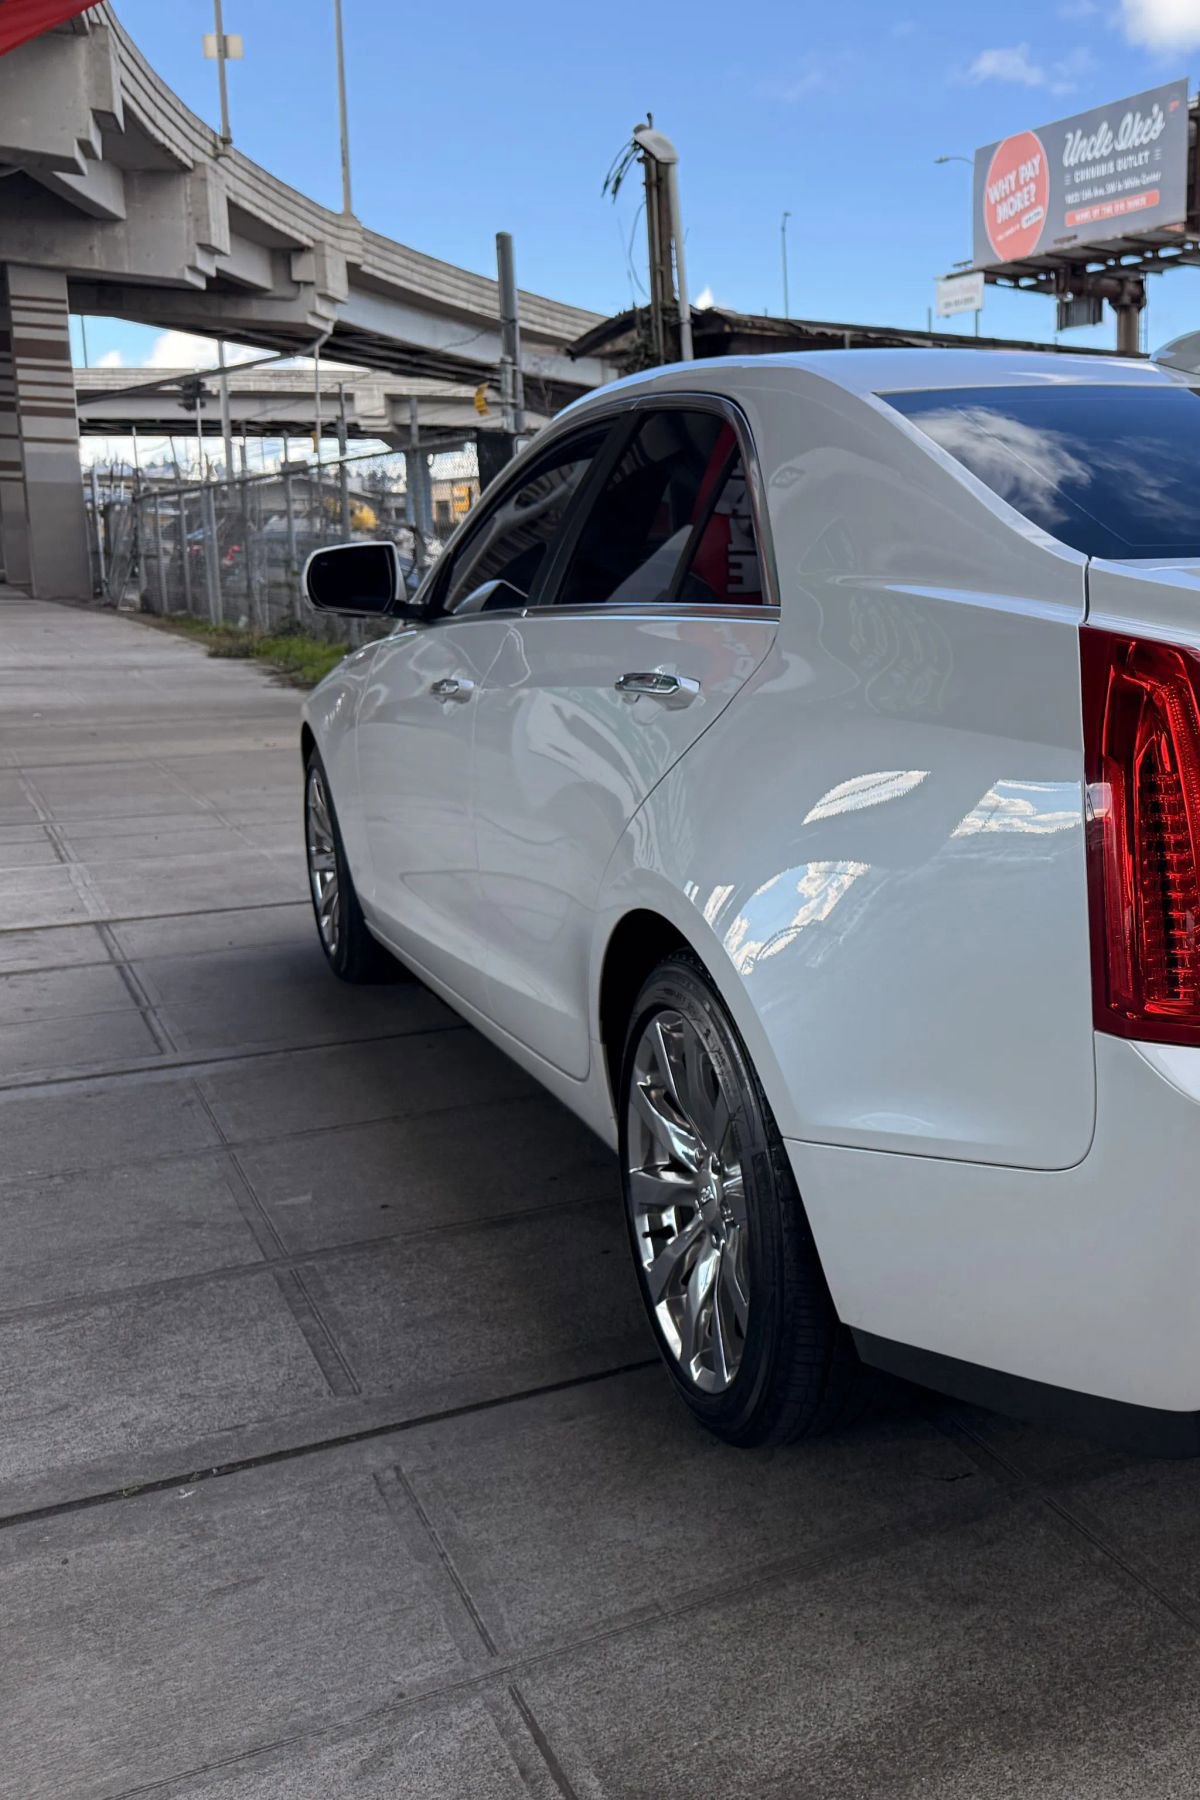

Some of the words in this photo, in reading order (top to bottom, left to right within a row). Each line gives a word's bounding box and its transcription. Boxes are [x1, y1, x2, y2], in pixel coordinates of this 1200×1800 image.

[1062, 120, 1114, 168] Uncle
[1114, 103, 1166, 151] Ike's
[988, 169, 1017, 205] WHY
[1018, 153, 1041, 186] PAY
[996, 182, 1037, 225] MORE?
